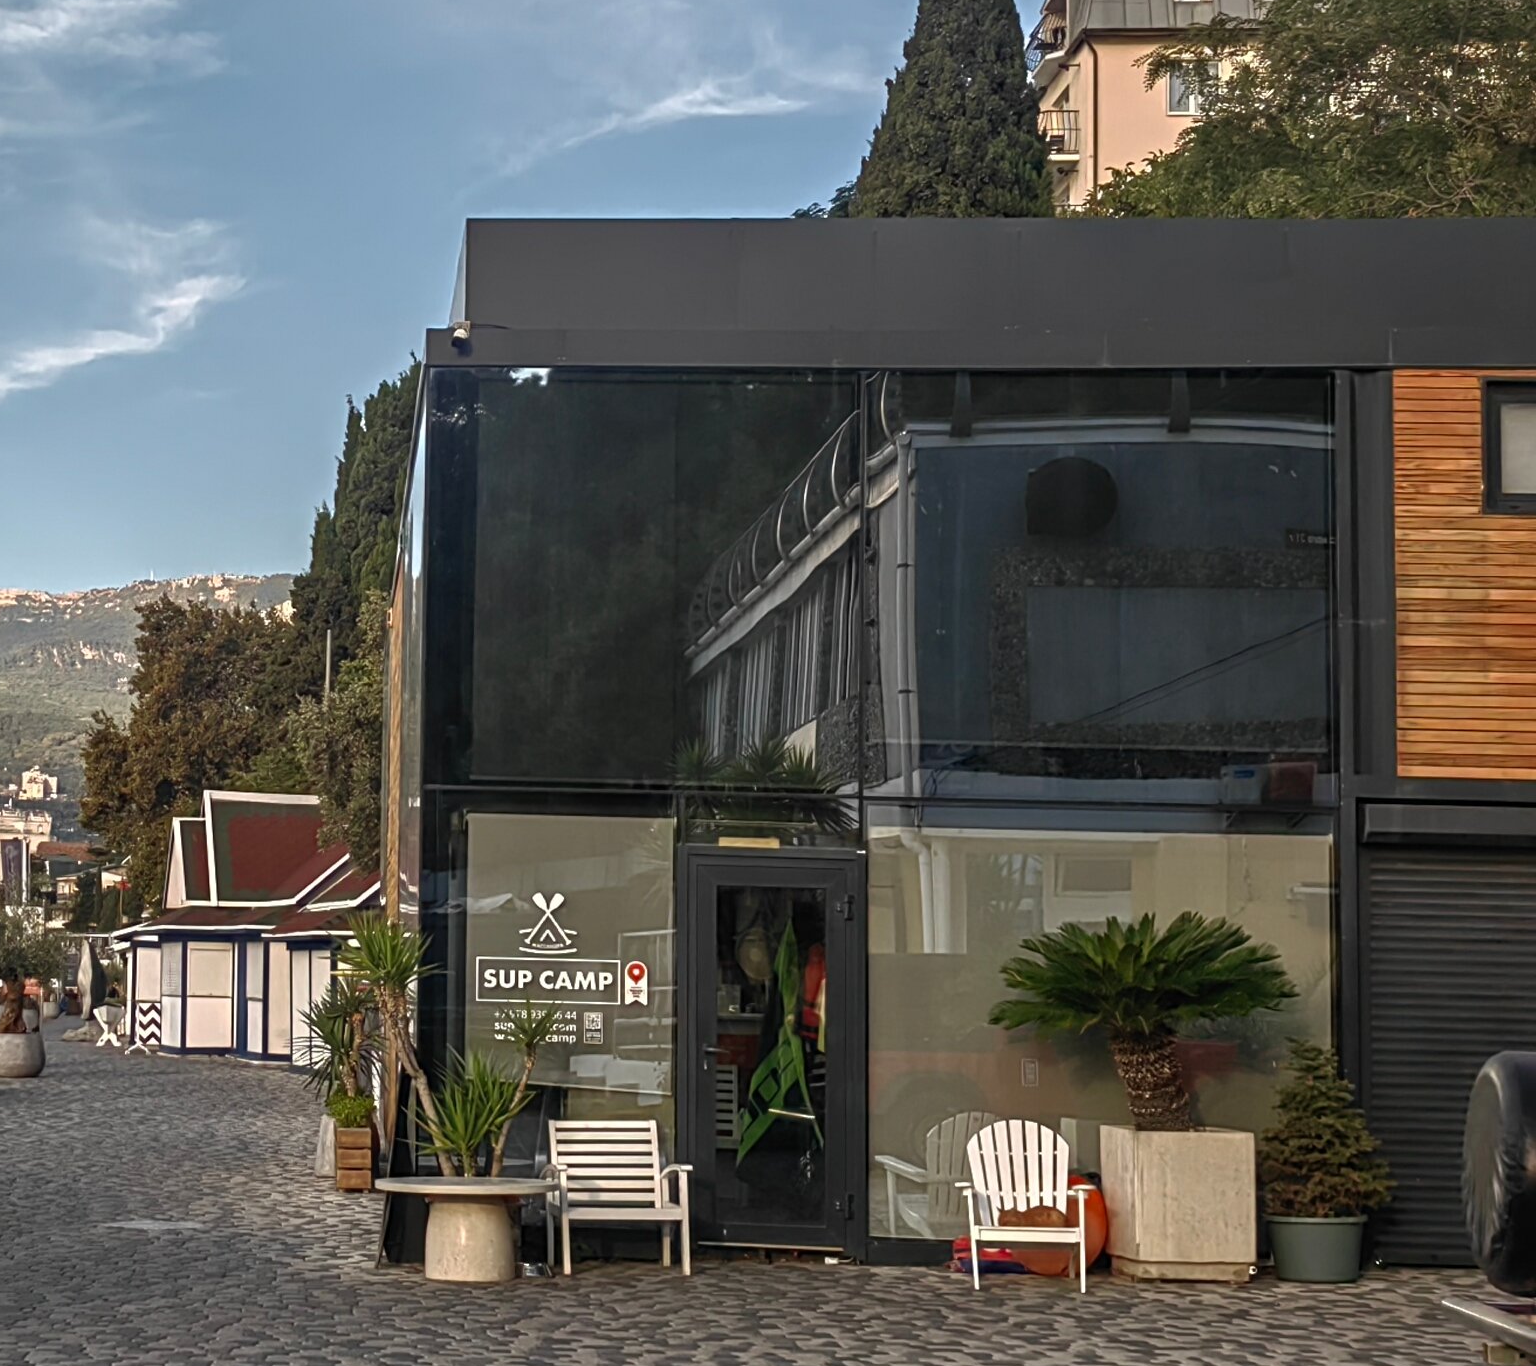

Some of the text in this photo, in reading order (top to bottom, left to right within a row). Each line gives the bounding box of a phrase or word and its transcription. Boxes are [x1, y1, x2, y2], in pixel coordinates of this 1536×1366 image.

[483, 968, 613, 991] SUP CAMP
[564, 1010, 577, 1020] 44
